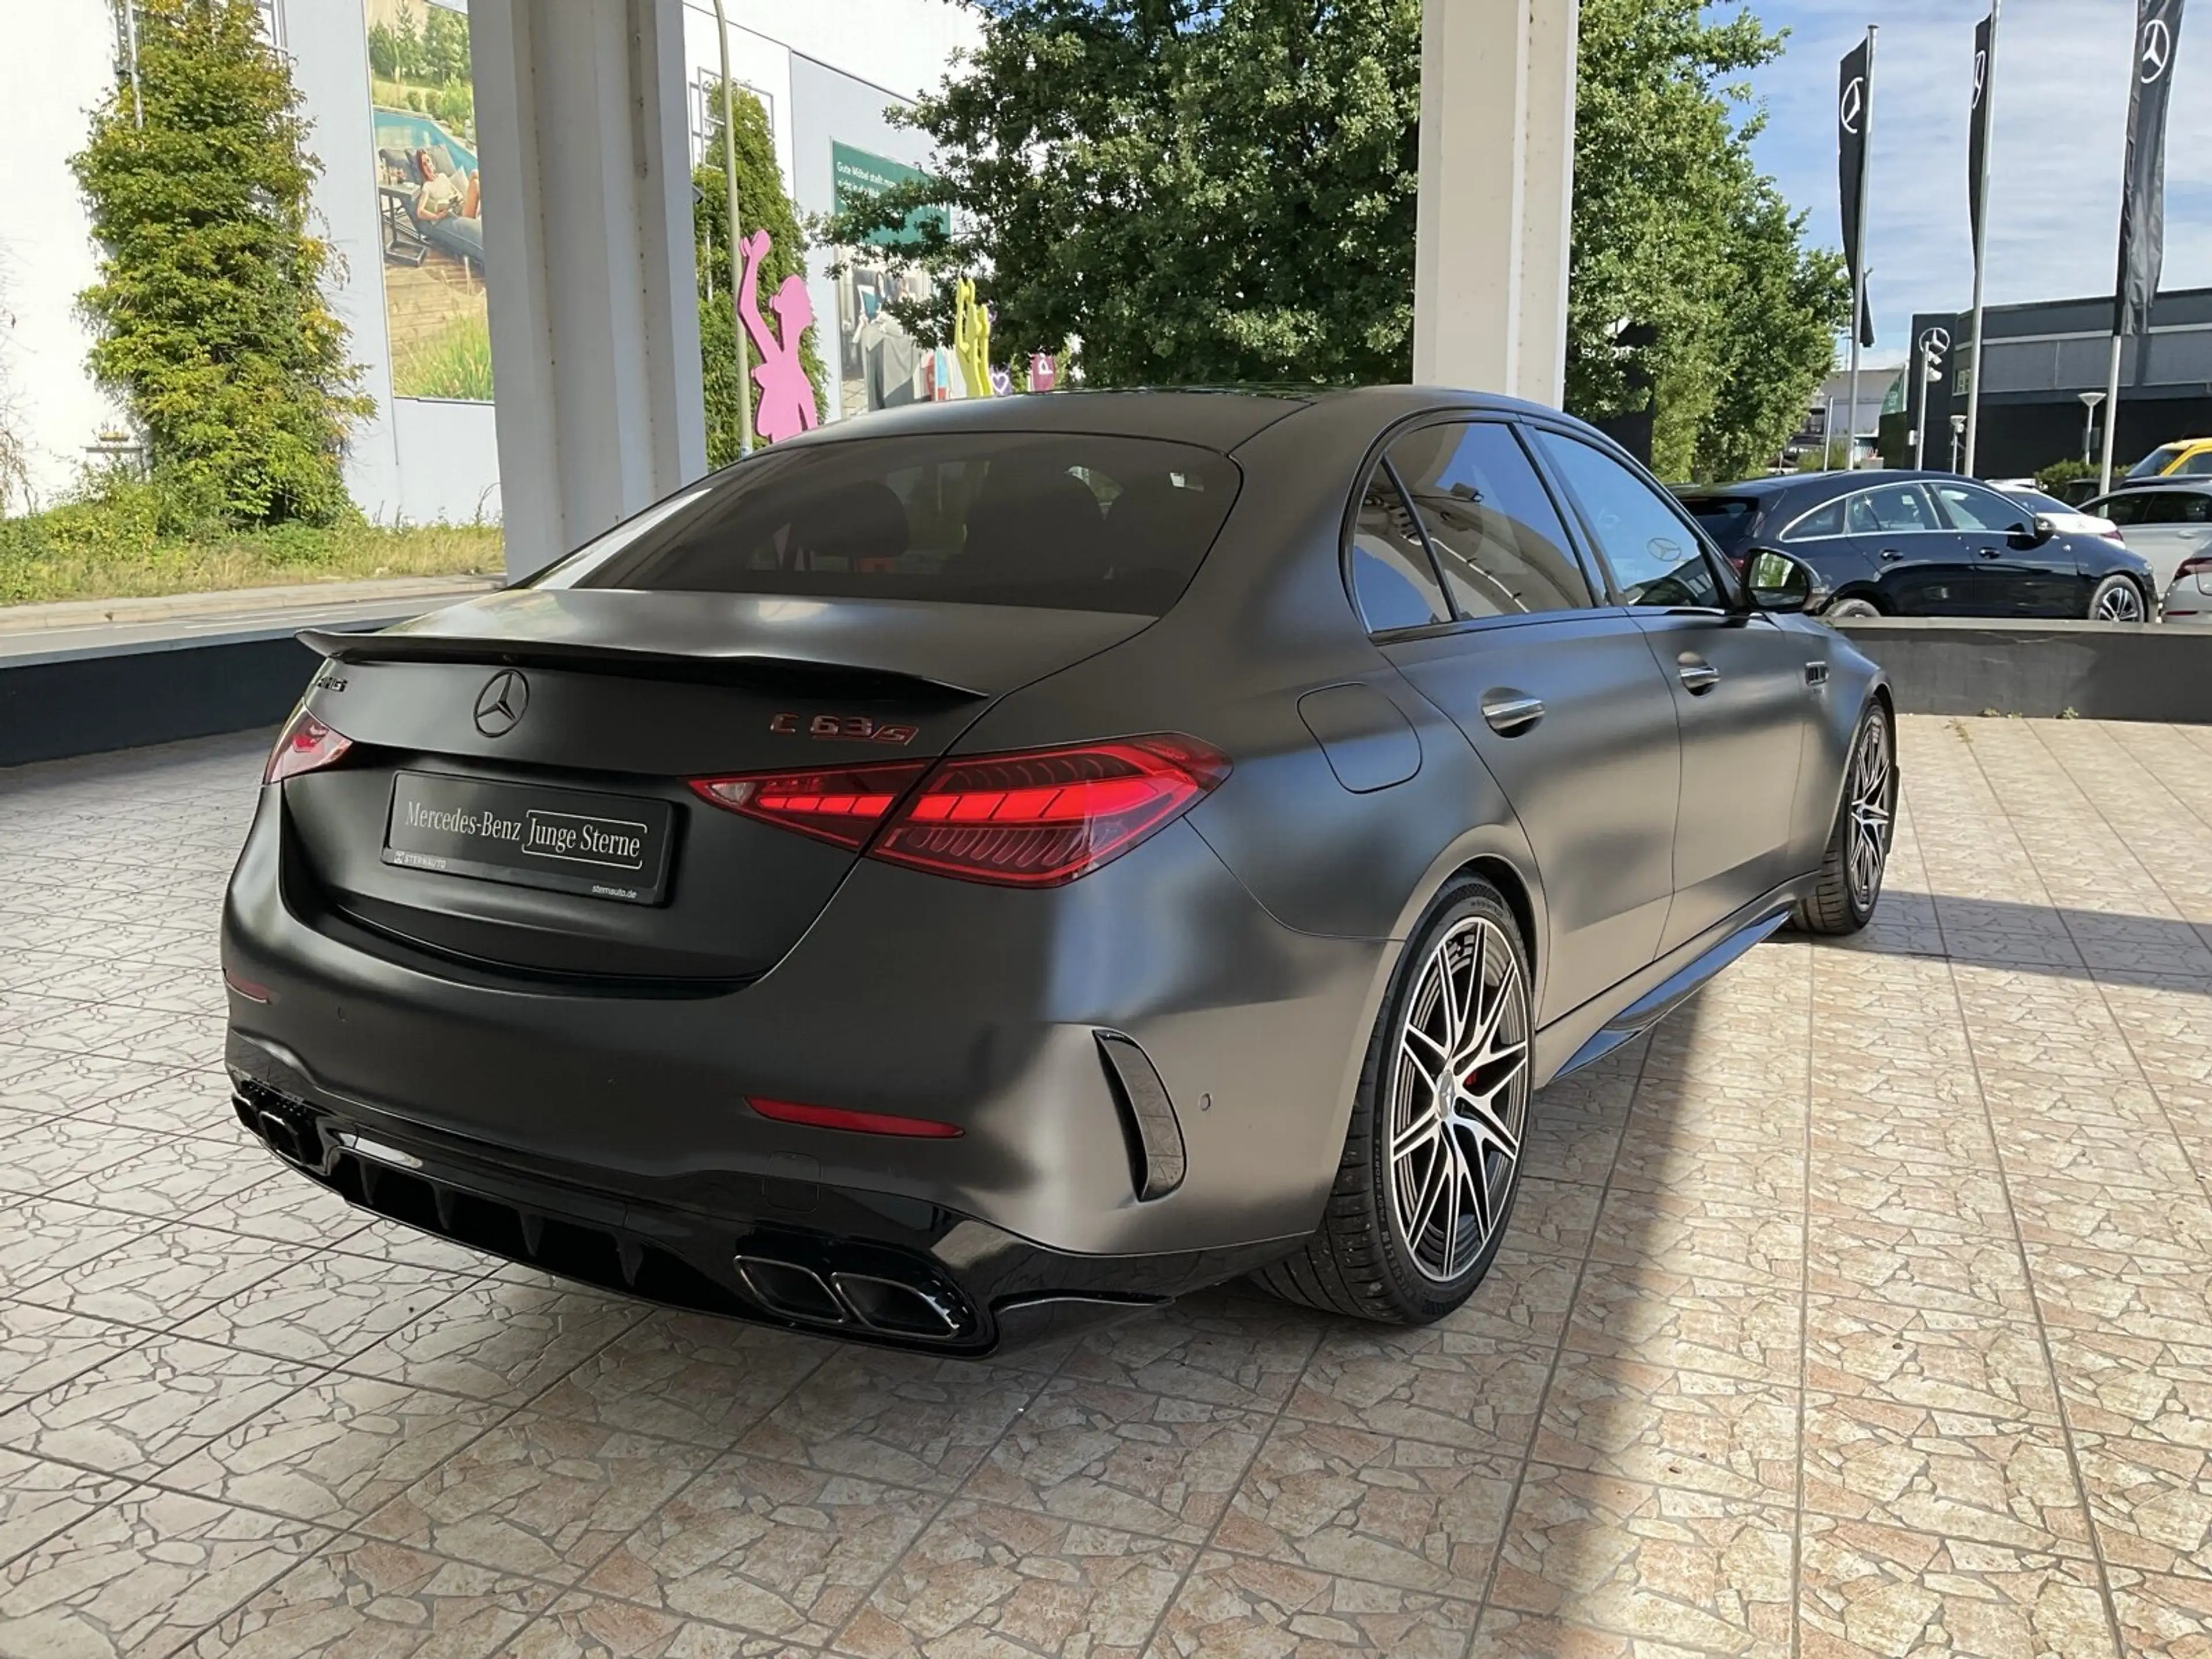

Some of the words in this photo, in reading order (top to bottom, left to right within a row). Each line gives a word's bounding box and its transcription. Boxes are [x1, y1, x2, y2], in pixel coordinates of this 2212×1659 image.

[405, 801, 522, 841] Mercedes-Benz
[527, 817, 577, 853] Junge
[580, 824, 641, 857] Sterne
[592, 884, 638, 899] sternauto.de
